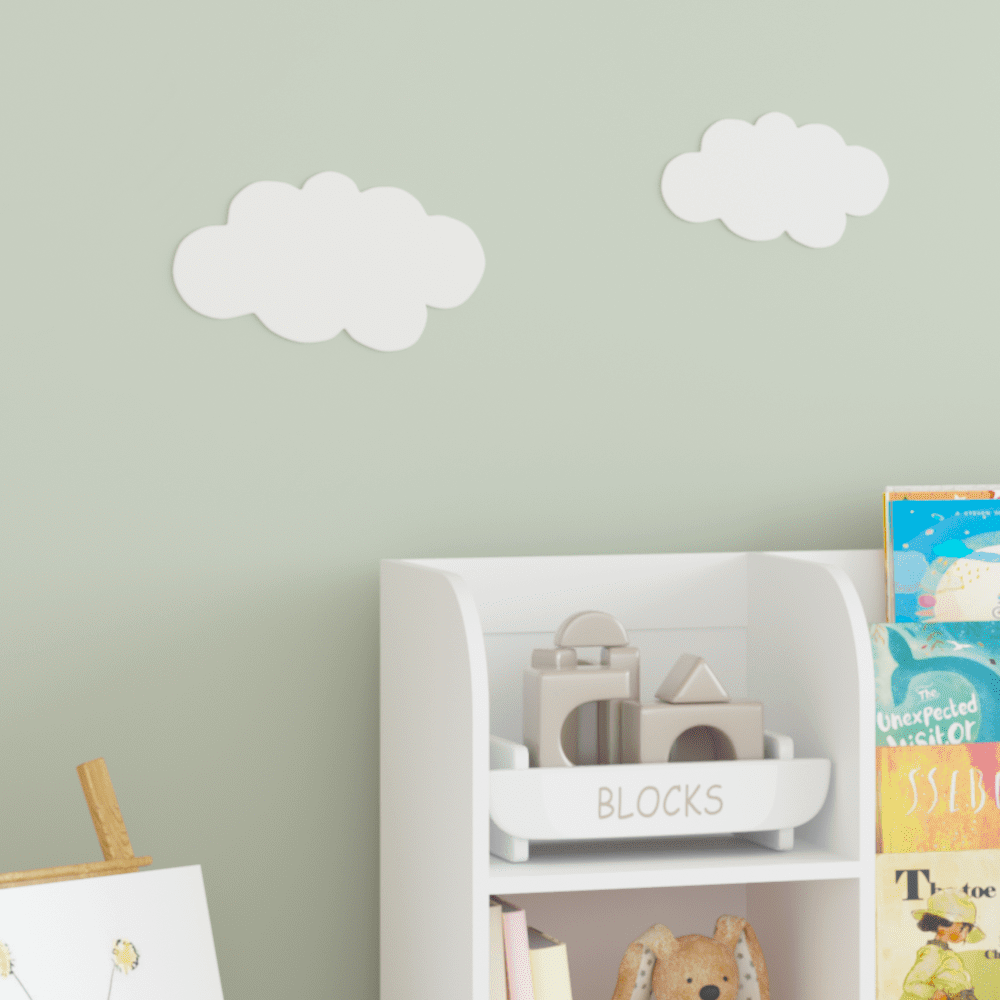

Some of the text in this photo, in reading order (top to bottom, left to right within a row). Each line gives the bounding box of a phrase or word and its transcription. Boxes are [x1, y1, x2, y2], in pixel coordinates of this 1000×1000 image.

[877, 693, 978, 732] Unexpected
[597, 784, 724, 820] BLOCKS
[895, 869, 957, 901] Th
[963, 882, 996, 899] toe
